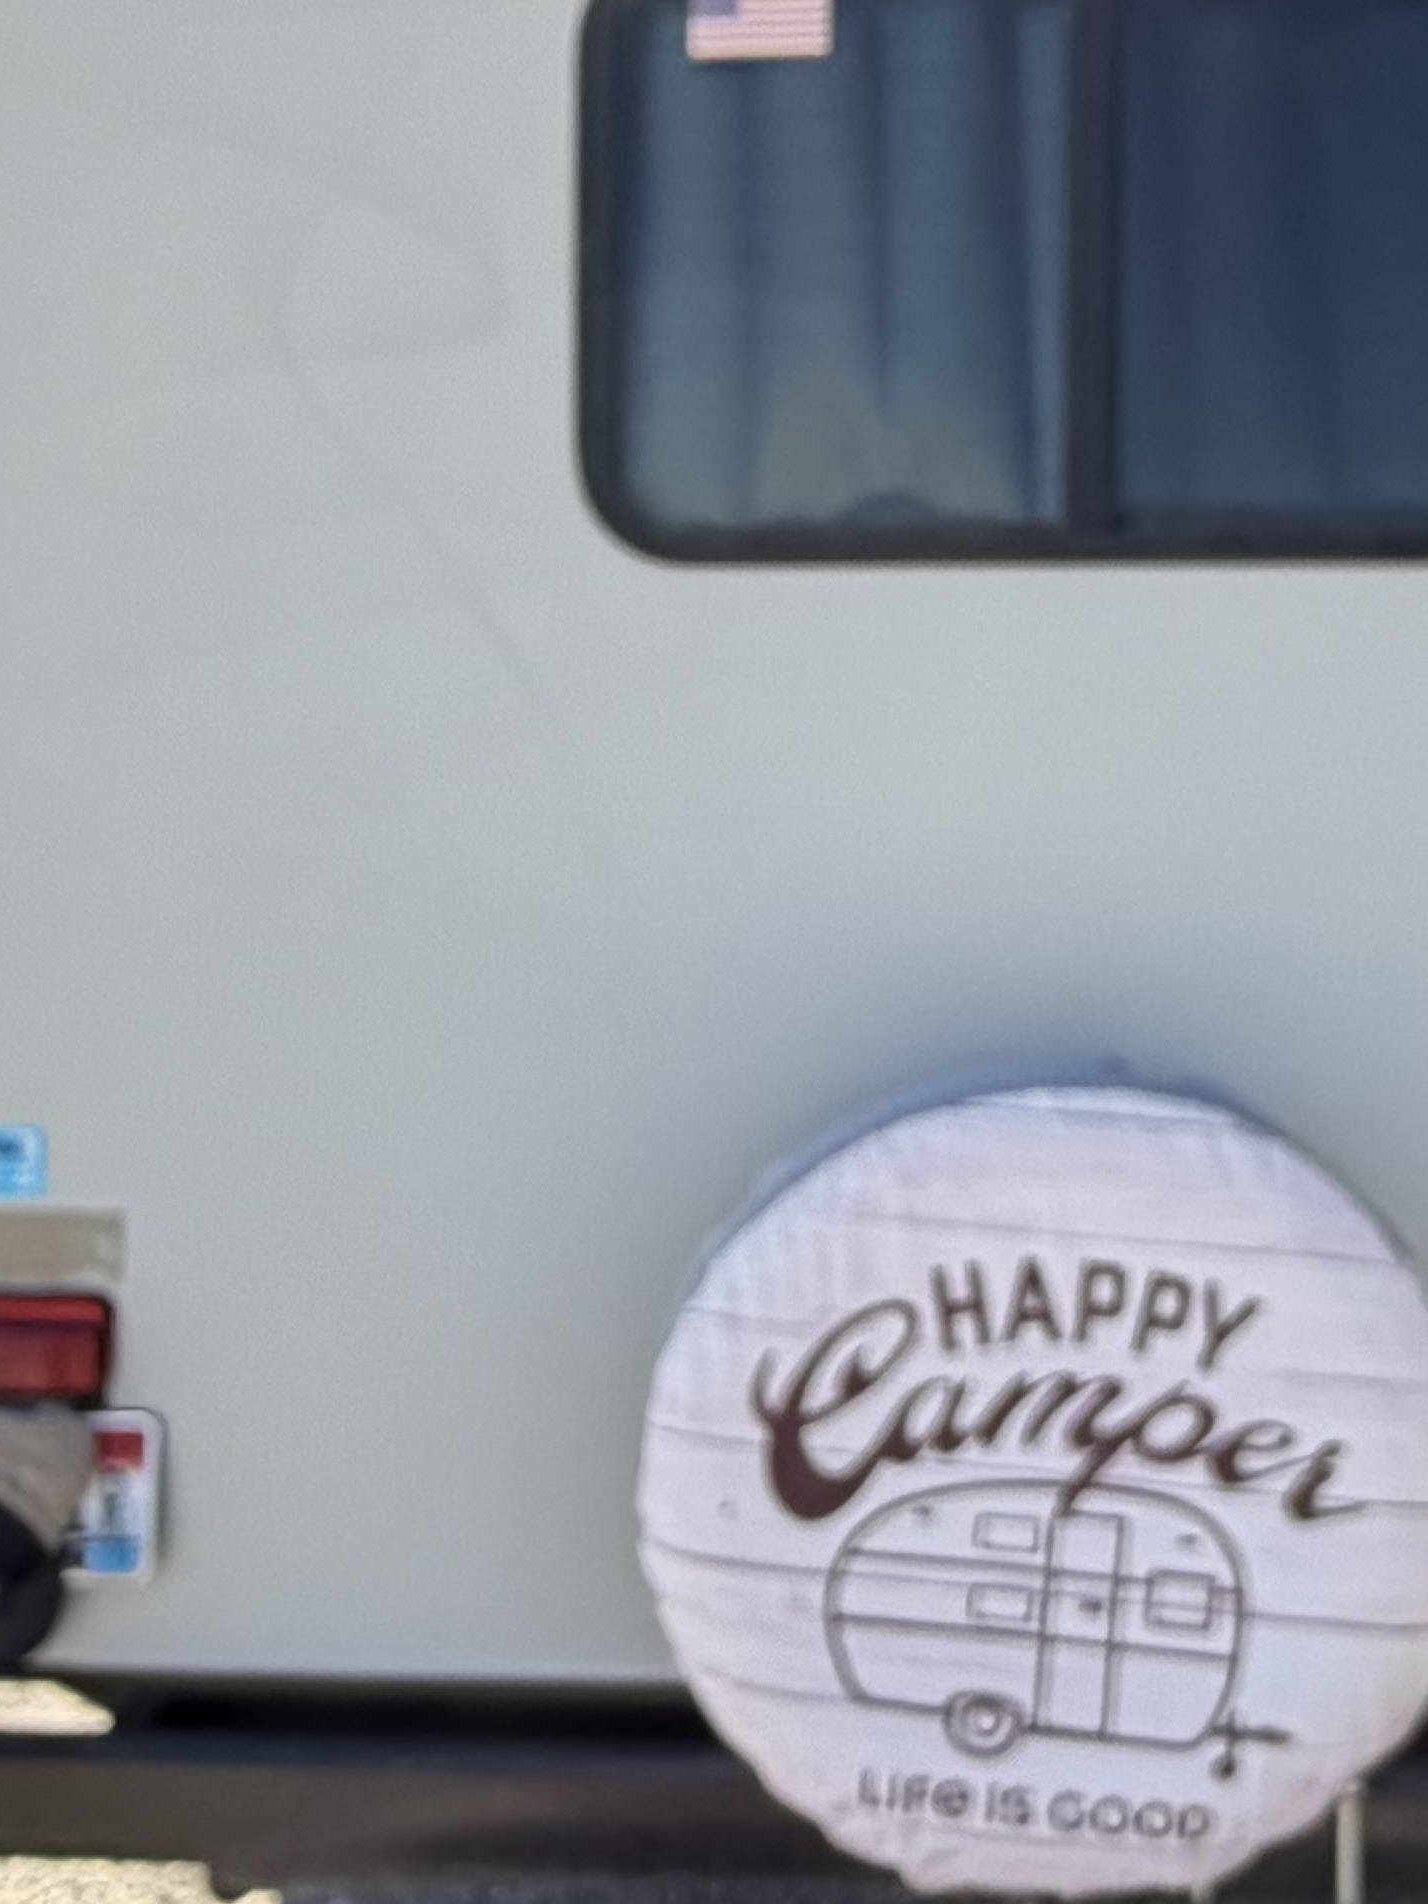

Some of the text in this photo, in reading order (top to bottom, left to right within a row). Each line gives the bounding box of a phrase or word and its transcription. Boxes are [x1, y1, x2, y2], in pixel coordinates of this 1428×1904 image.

[927, 1255, 1261, 1372] HAPPY
[749, 1298, 1369, 1521] Camper
[985, 1782, 1033, 1826] IS
[1047, 1790, 1211, 1839] GOOD
